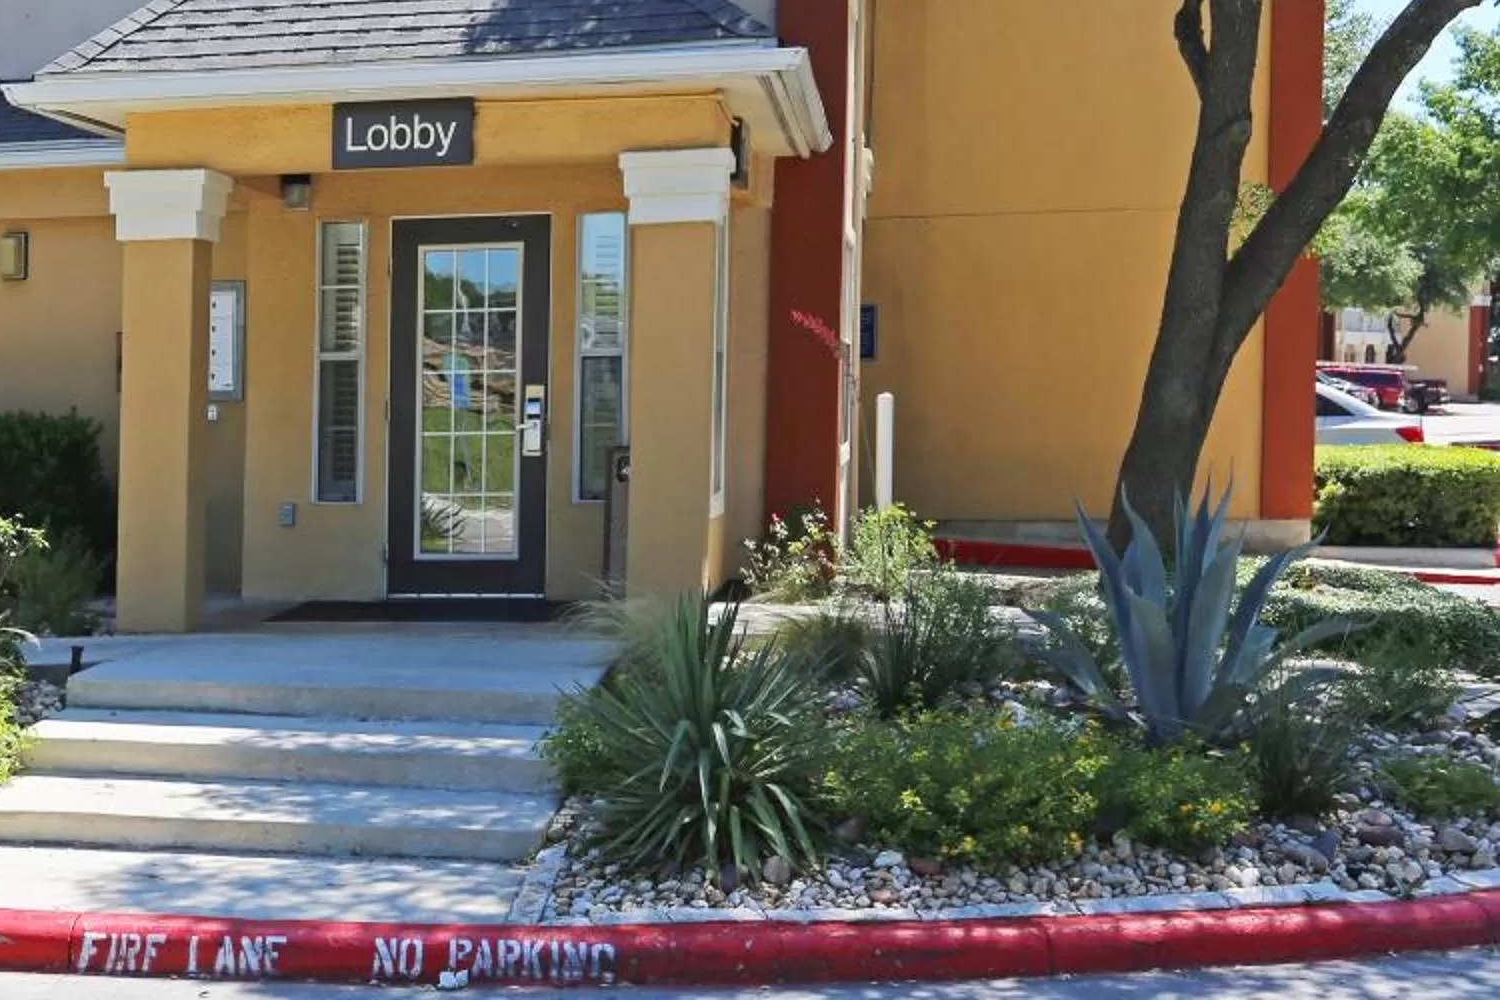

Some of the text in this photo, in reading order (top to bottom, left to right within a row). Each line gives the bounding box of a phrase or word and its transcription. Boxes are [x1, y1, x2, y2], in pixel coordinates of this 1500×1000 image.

[345, 113, 457, 157] Lobby
[372, 936, 424, 977] NO
[448, 937, 617, 983] PARKING
